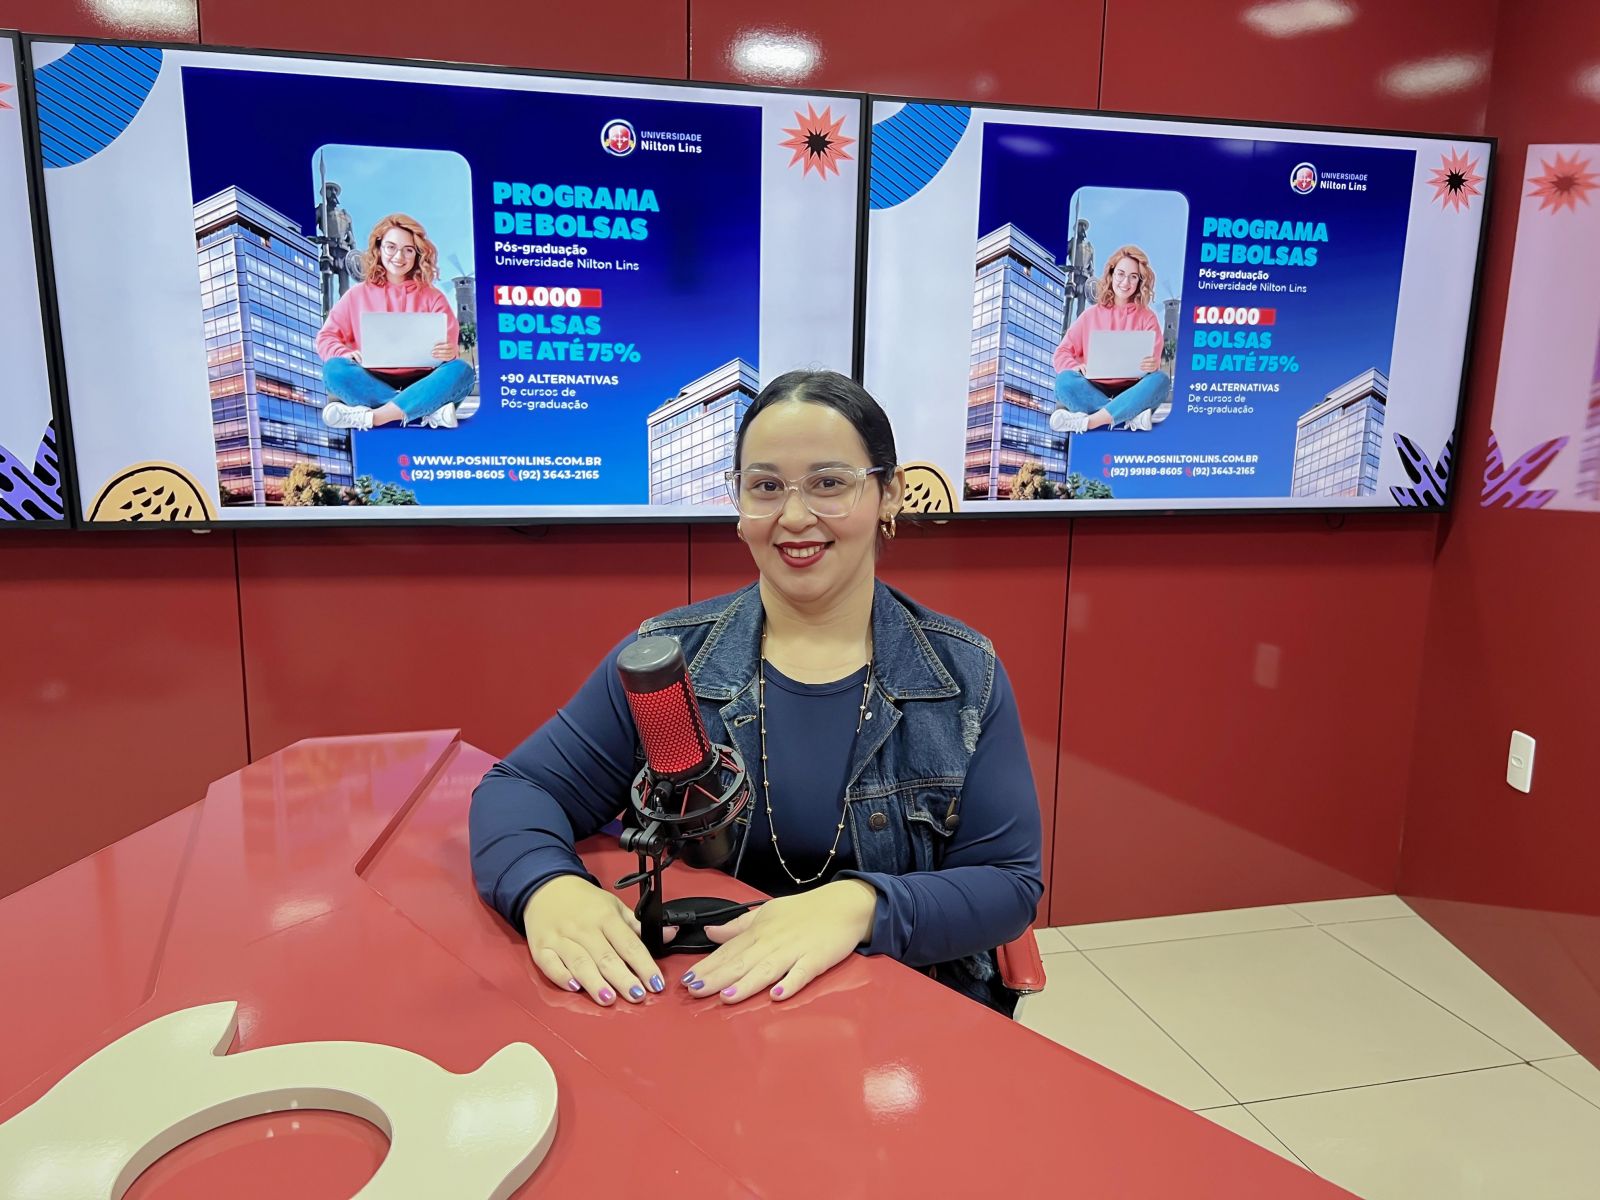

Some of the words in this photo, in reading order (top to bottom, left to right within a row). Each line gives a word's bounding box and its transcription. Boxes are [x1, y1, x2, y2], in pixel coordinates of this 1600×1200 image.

[641, 130, 702, 142] UNIVERSIDADE
[641, 140, 675, 152] Nilton
[678, 142, 702, 154] Lins
[493, 181, 659, 212] PROGRAMA
[1203, 217, 1328, 242] PROGRAMA
[495, 241, 587, 256] Pós-graduação
[495, 255, 574, 269] Universidade
[577, 258, 612, 270] Nilton
[615, 260, 639, 271] Lins
[497, 286, 582, 307] 10.000
[1196, 306, 1260, 325] 10.000
[498, 313, 601, 335] BOLSAS
[1193, 330, 1272, 349] BOLSAS
[588, 343, 642, 363] 75%
[1258, 355, 1300, 372] 75%
[500, 374, 524, 383] +90
[527, 374, 619, 385] ALTERNATIVAS
[501, 386, 517, 397] De
[520, 387, 558, 397] cursos
[561, 388, 577, 397] de
[501, 398, 589, 410] Pós-graduação
[412, 455, 602, 466] WWW.POSNILTONLINS.COM.BR
[411, 469, 434, 481] (92)
[436, 470, 505, 480] 99188-8605
[518, 469, 541, 481] (92)
[543, 470, 600, 480] 3643-2165
